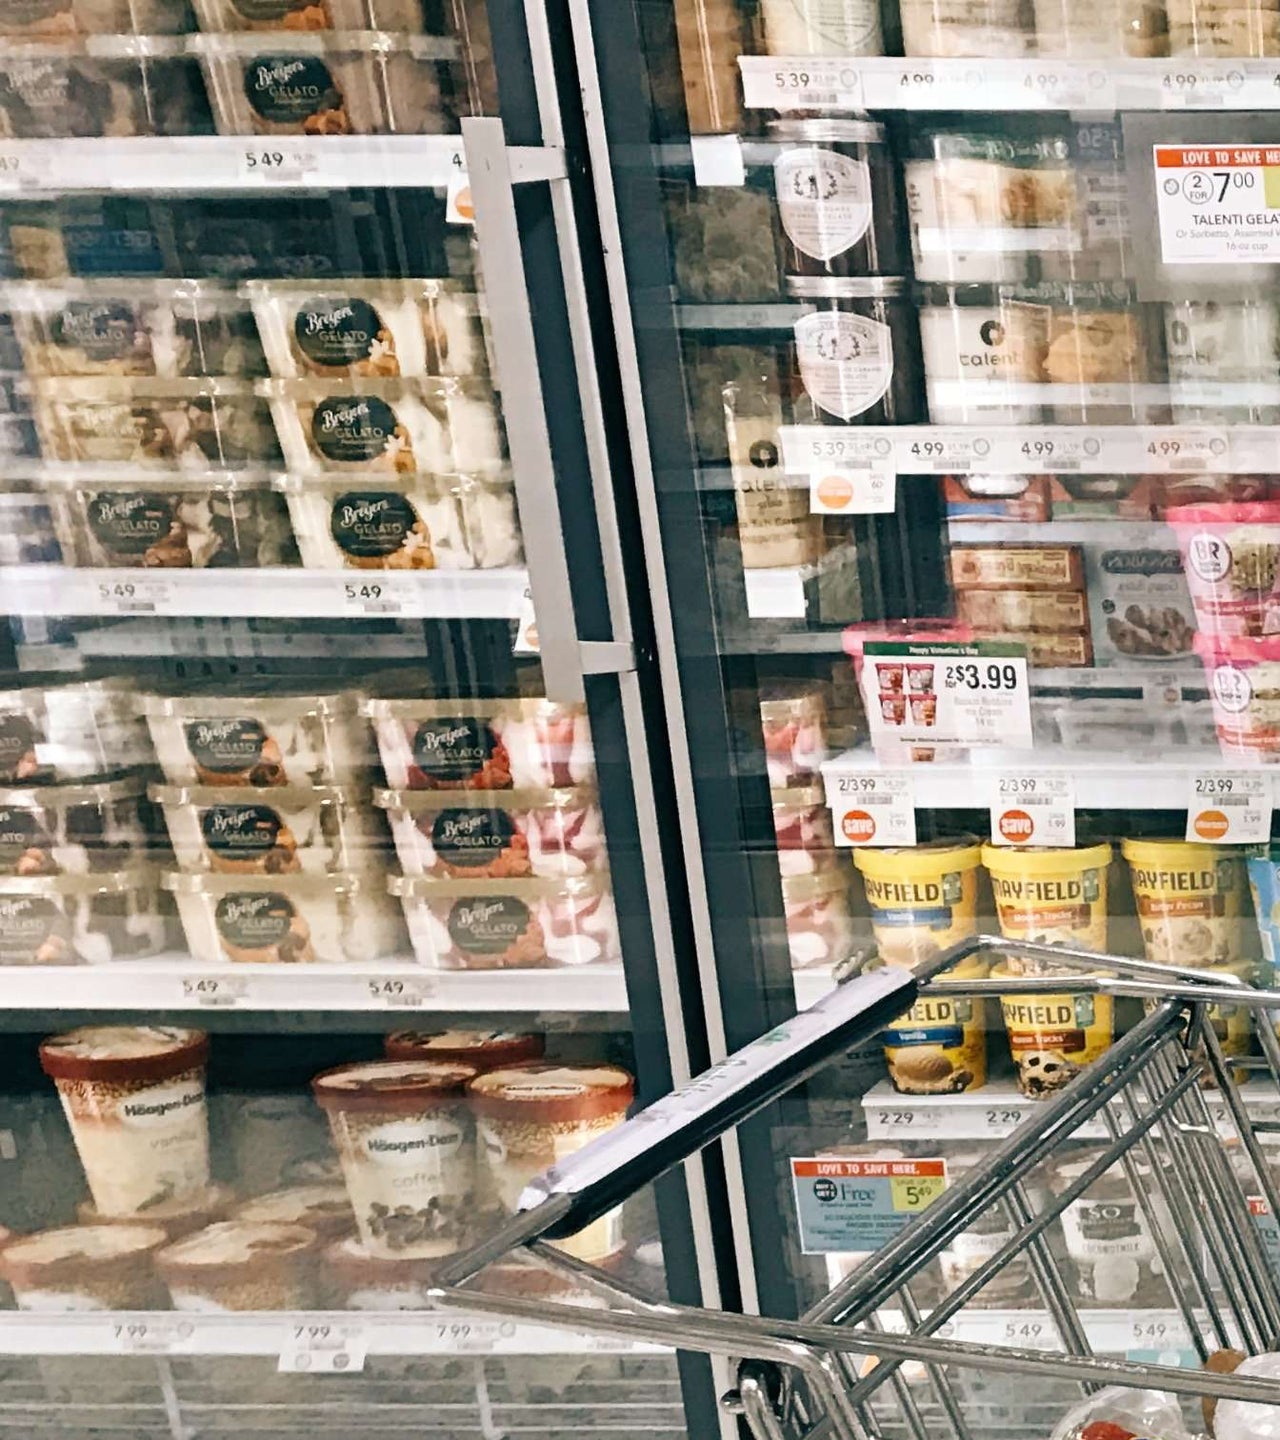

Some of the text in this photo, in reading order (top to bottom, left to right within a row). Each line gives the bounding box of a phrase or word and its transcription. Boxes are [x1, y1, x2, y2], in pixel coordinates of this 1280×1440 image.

[1183, 152, 1210, 164] LOVE
[1215, 152, 1229, 164] TO
[1235, 152, 1262, 163] SAVE
[1192, 214, 1243, 225] TALENTI
[946, 668, 954, 678] 2
[957, 664, 1016, 689] $3.99
[842, 818, 876, 834] save
[1001, 818, 1034, 835] save
[817, 1164, 841, 1174] LOVE
[846, 1164, 859, 1174] TO
[865, 1163, 888, 1174] SAVE
